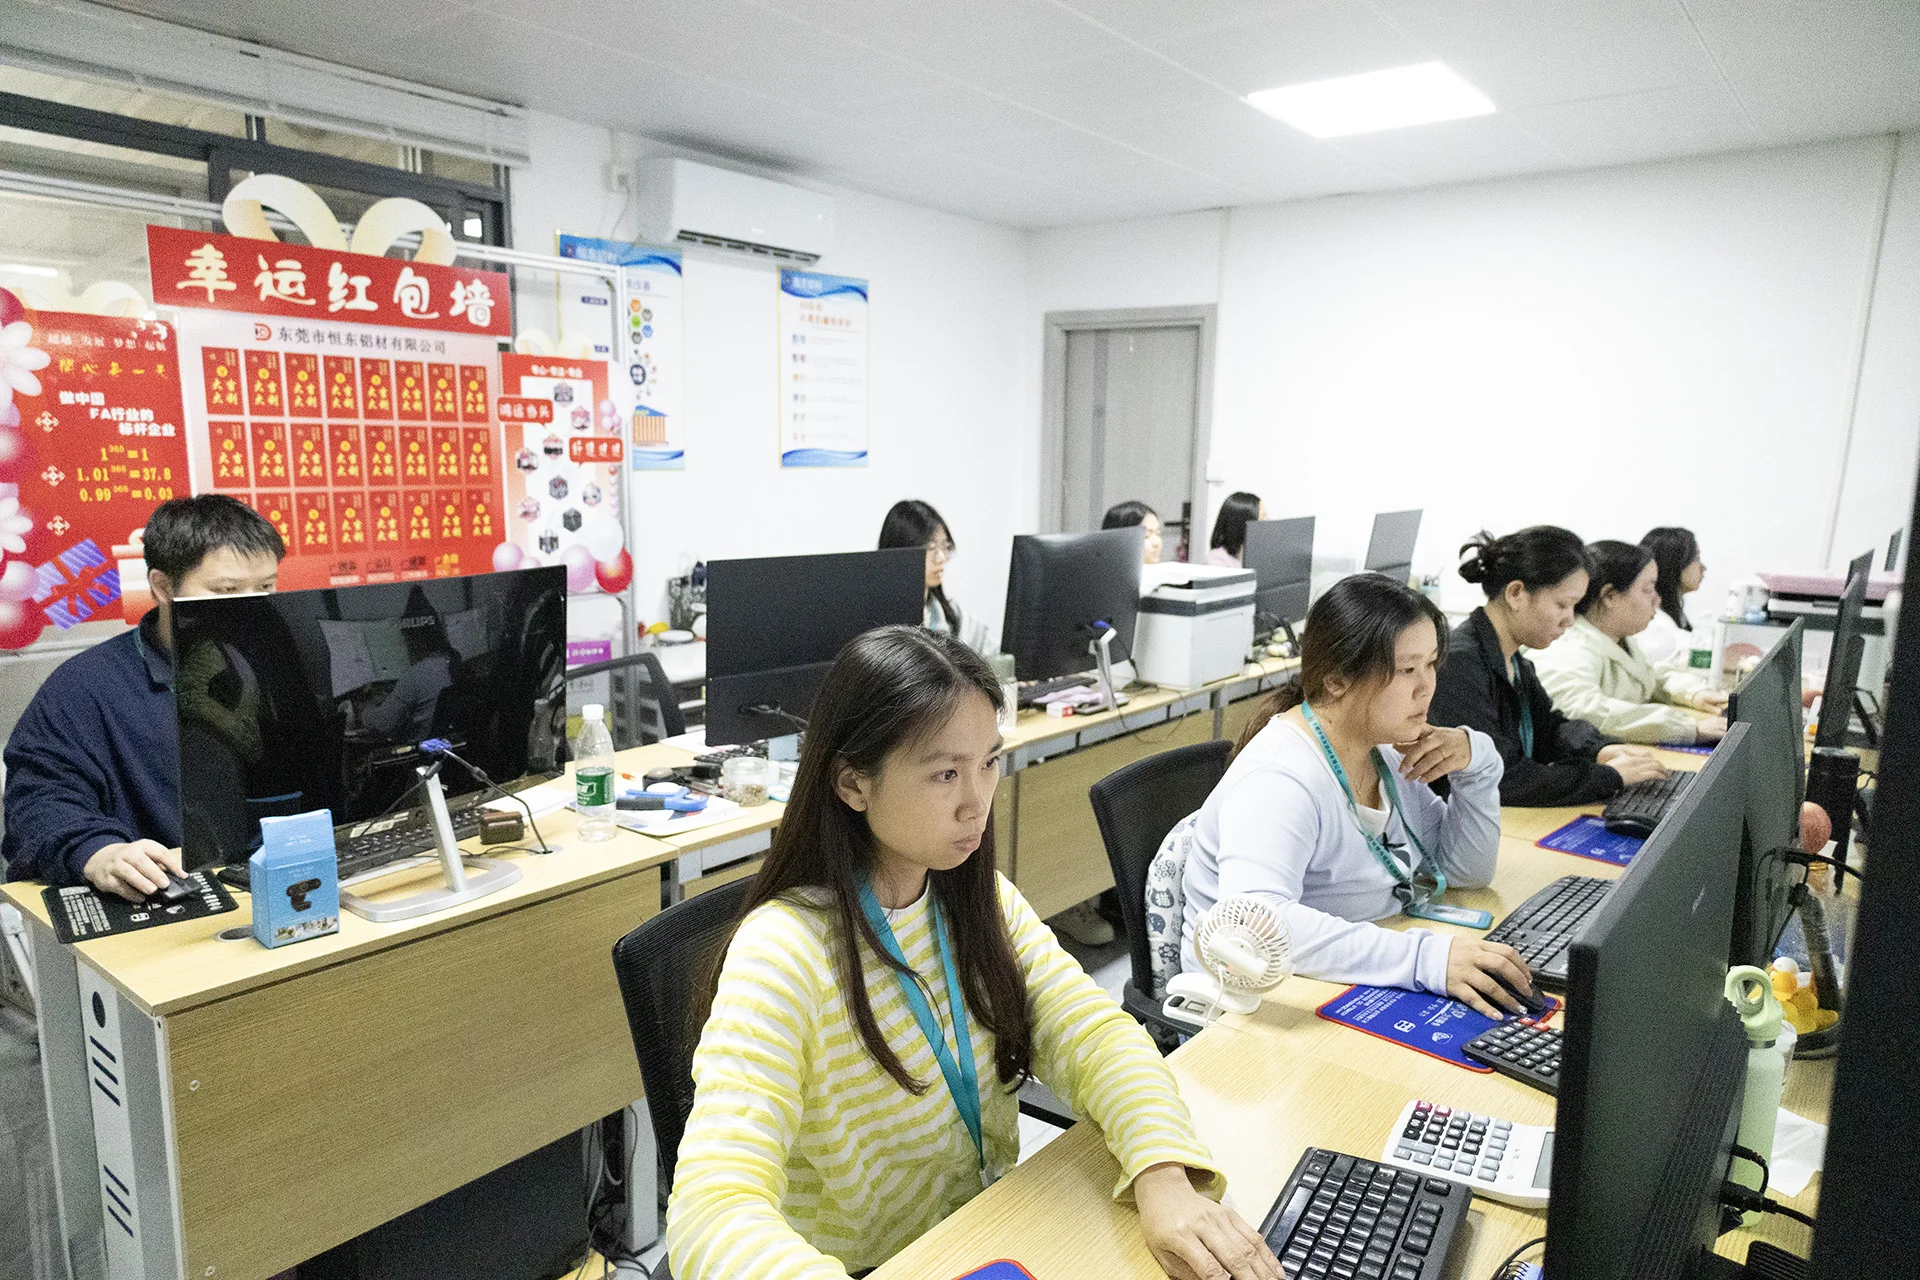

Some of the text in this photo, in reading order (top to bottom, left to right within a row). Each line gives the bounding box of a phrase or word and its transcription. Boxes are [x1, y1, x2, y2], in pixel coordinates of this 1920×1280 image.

[176, 243, 495, 328] 幸运红包墙
[277, 326, 447, 355] 东莞市恒东铝材有限公司
